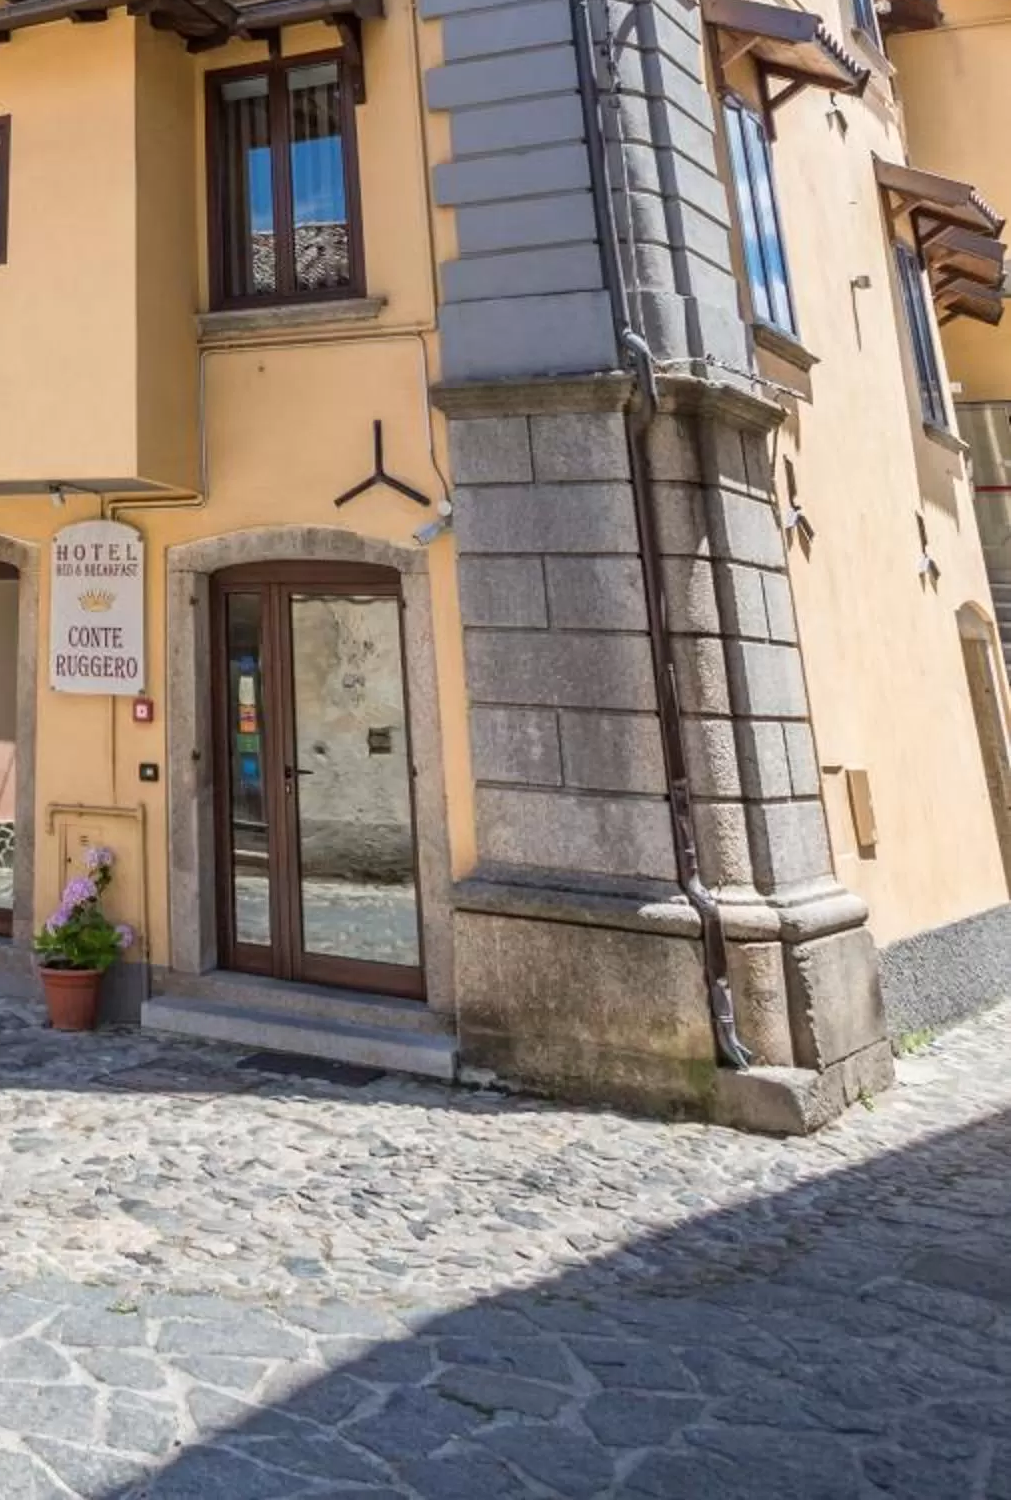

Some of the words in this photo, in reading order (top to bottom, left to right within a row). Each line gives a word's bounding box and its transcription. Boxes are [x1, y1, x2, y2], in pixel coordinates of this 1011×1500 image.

[56, 543, 138, 561] HOTEL
[84, 563, 138, 577] BREAKFAST
[68, 625, 124, 649] CONTE
[55, 655, 138, 679] RUGGERO
